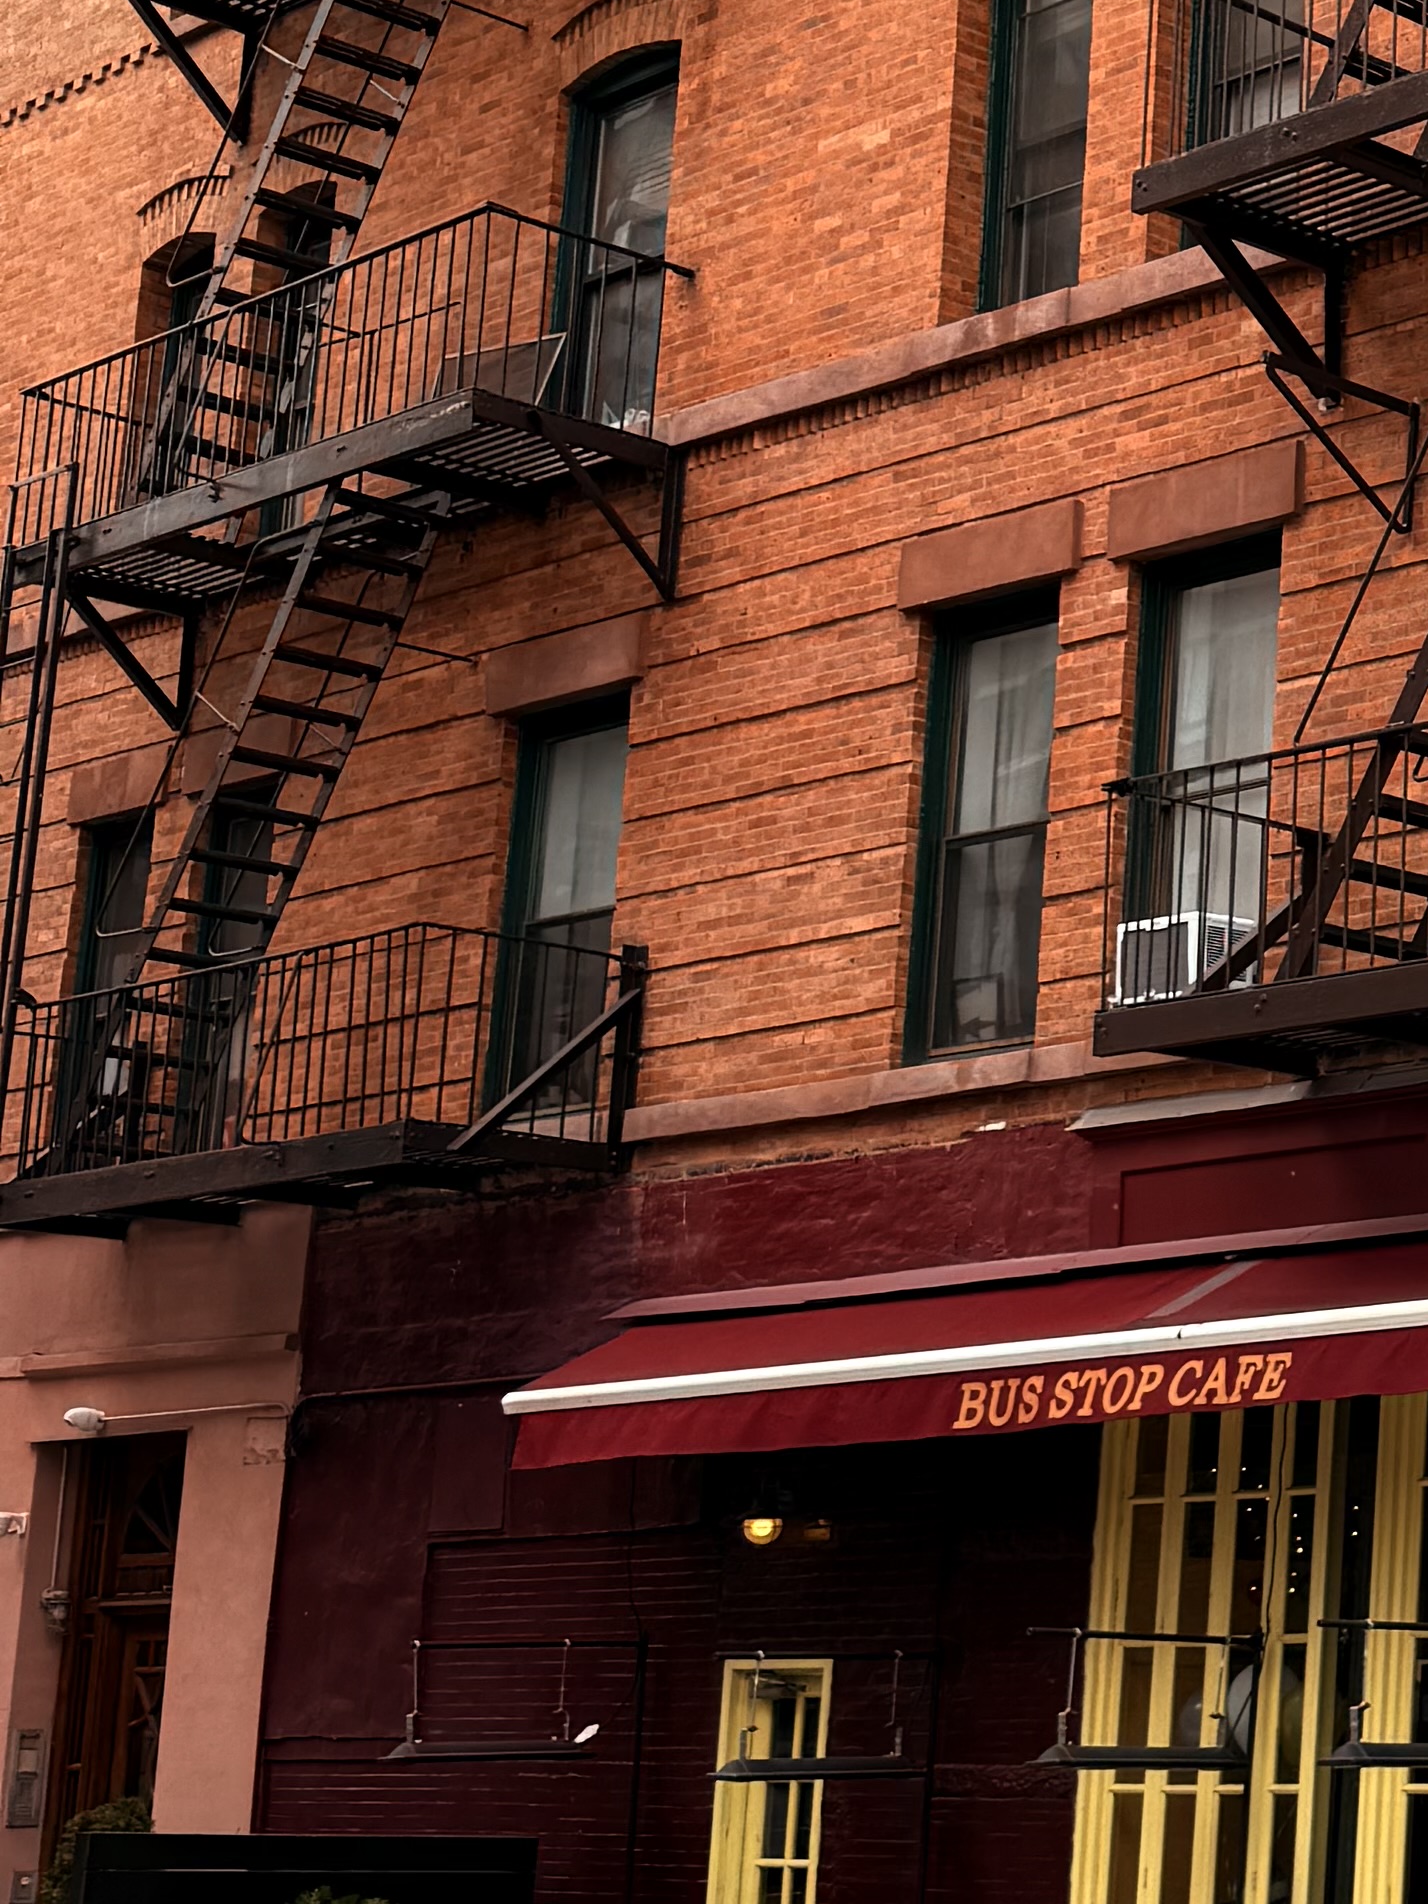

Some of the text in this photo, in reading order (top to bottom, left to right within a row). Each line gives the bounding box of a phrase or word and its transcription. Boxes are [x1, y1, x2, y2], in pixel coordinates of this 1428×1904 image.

[953, 1352, 1292, 1429] BUS STOP CAFE
